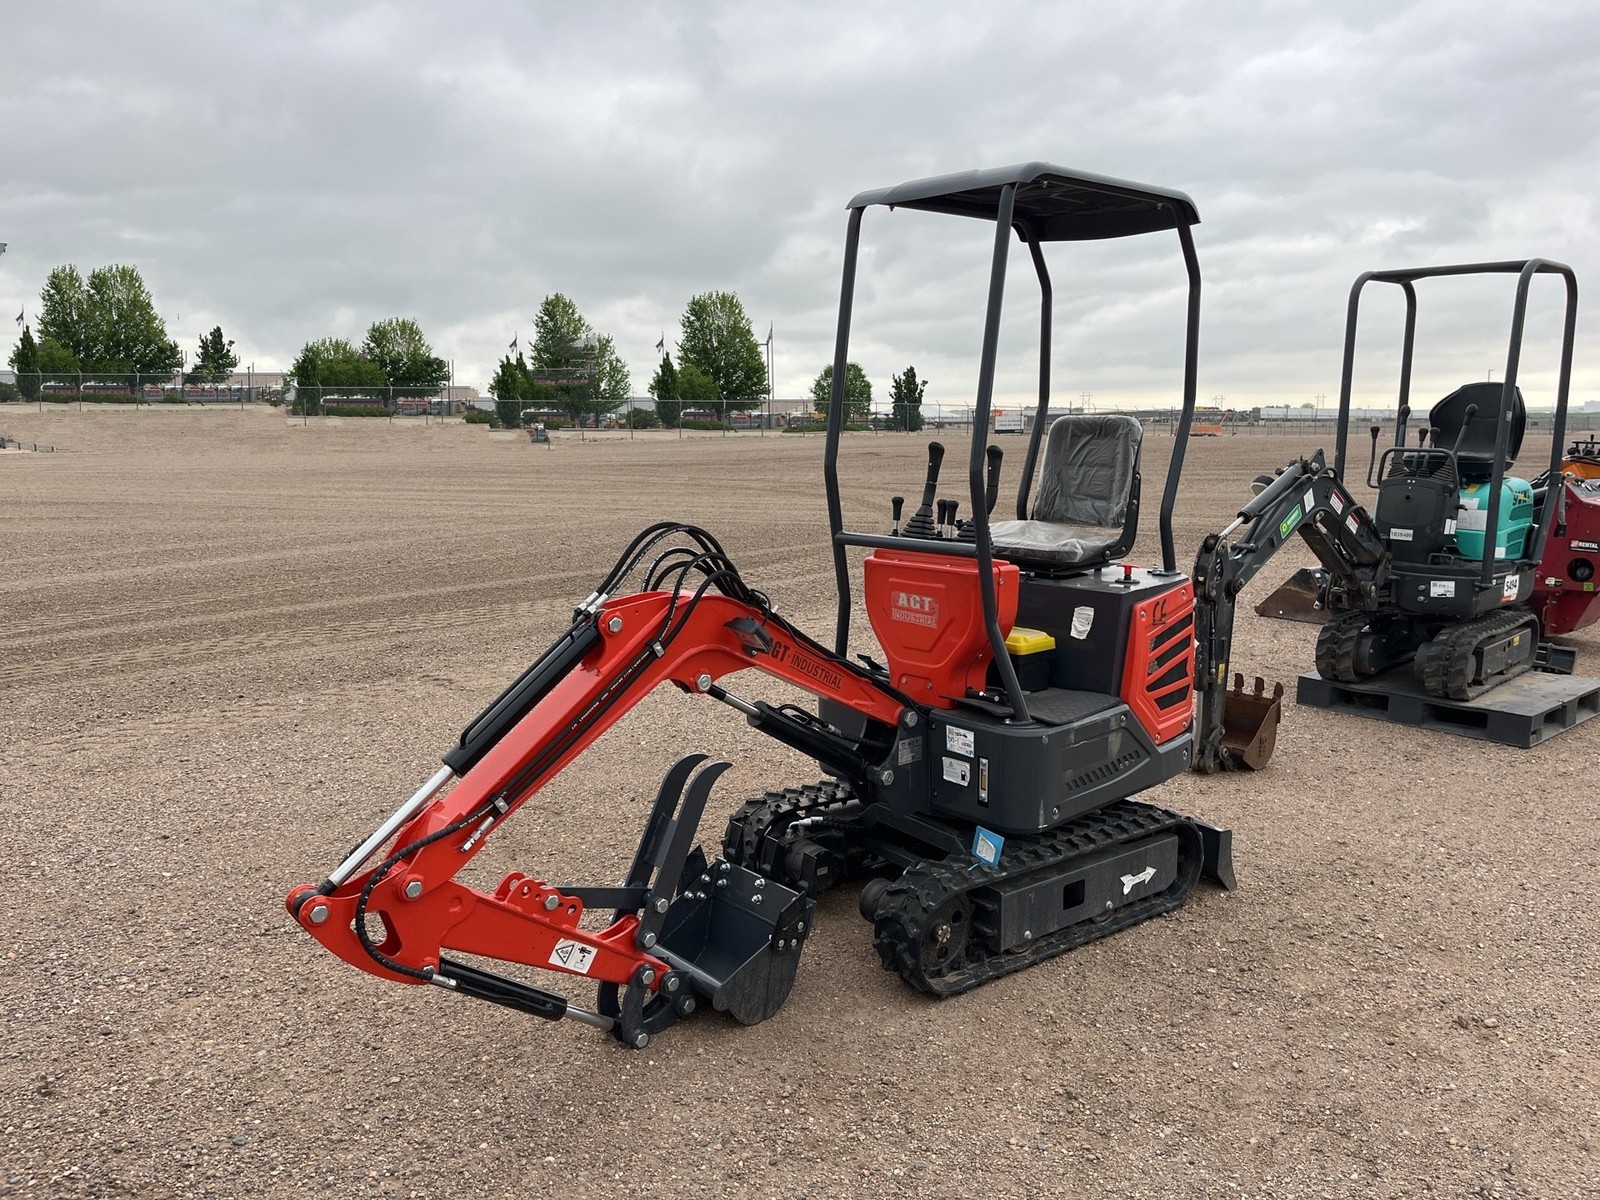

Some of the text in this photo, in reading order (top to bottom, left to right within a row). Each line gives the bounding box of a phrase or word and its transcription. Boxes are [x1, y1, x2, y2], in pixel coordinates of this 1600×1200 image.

[898, 592, 932, 611] AGT
[891, 609, 938, 628] INDUSTRIAL
[767, 638, 842, 690] GT INDUSTRIAL
